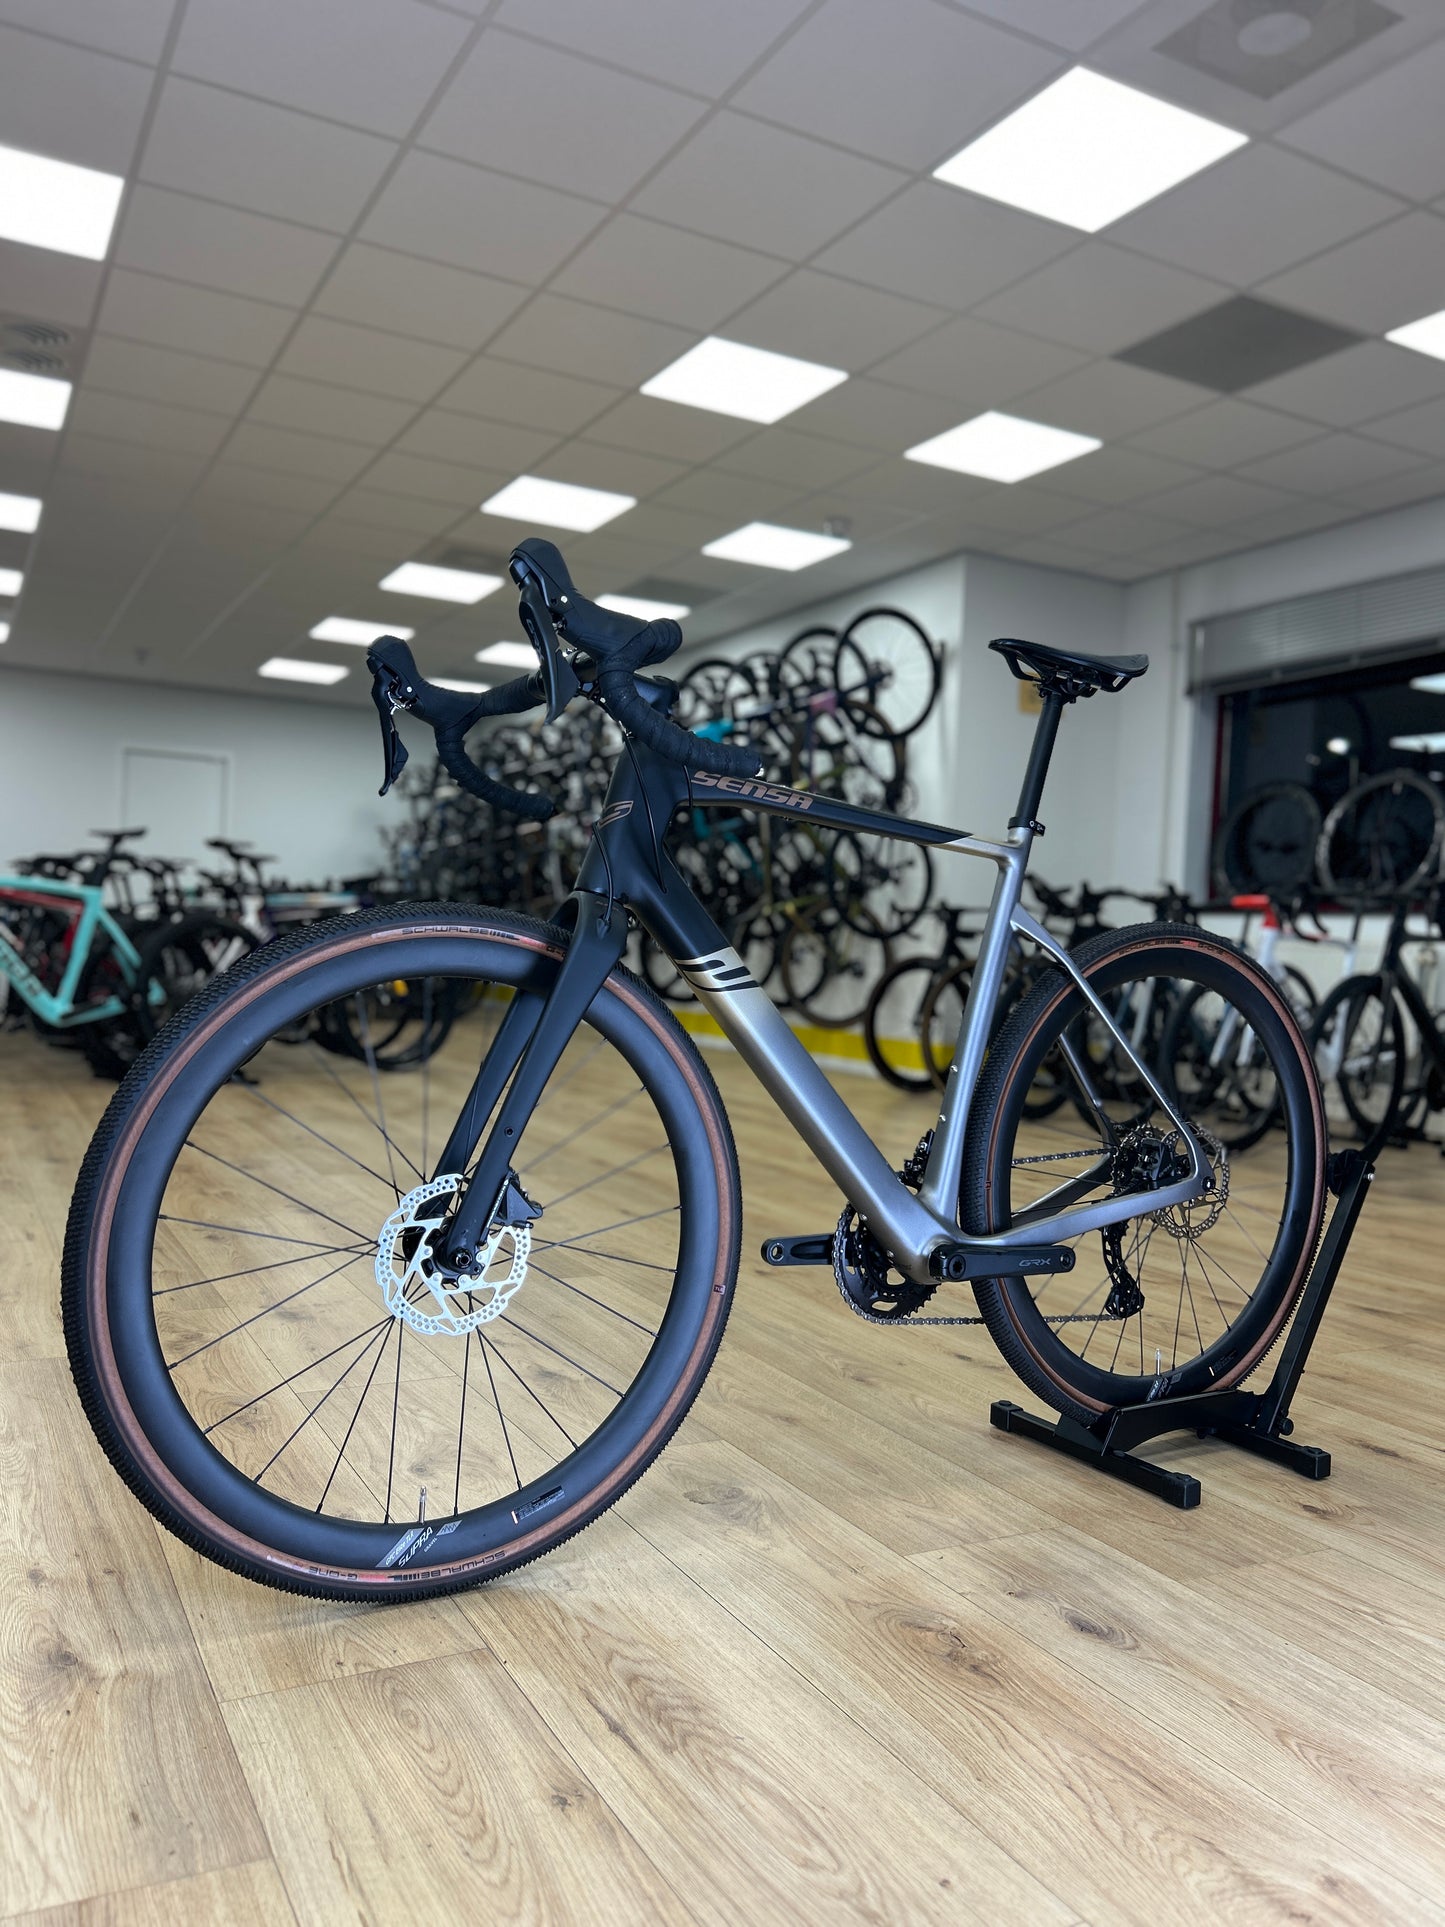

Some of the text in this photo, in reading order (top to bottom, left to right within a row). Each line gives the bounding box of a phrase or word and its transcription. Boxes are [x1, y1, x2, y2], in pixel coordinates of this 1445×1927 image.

[690, 770, 814, 810] SENSA
[402, 926, 490, 935] SCHWALBE
[1019, 1258, 1051, 1267] GRX
[398, 1526, 433, 1568] SUPRA
[308, 1550, 506, 1580] SCHWALBE G-ONE
